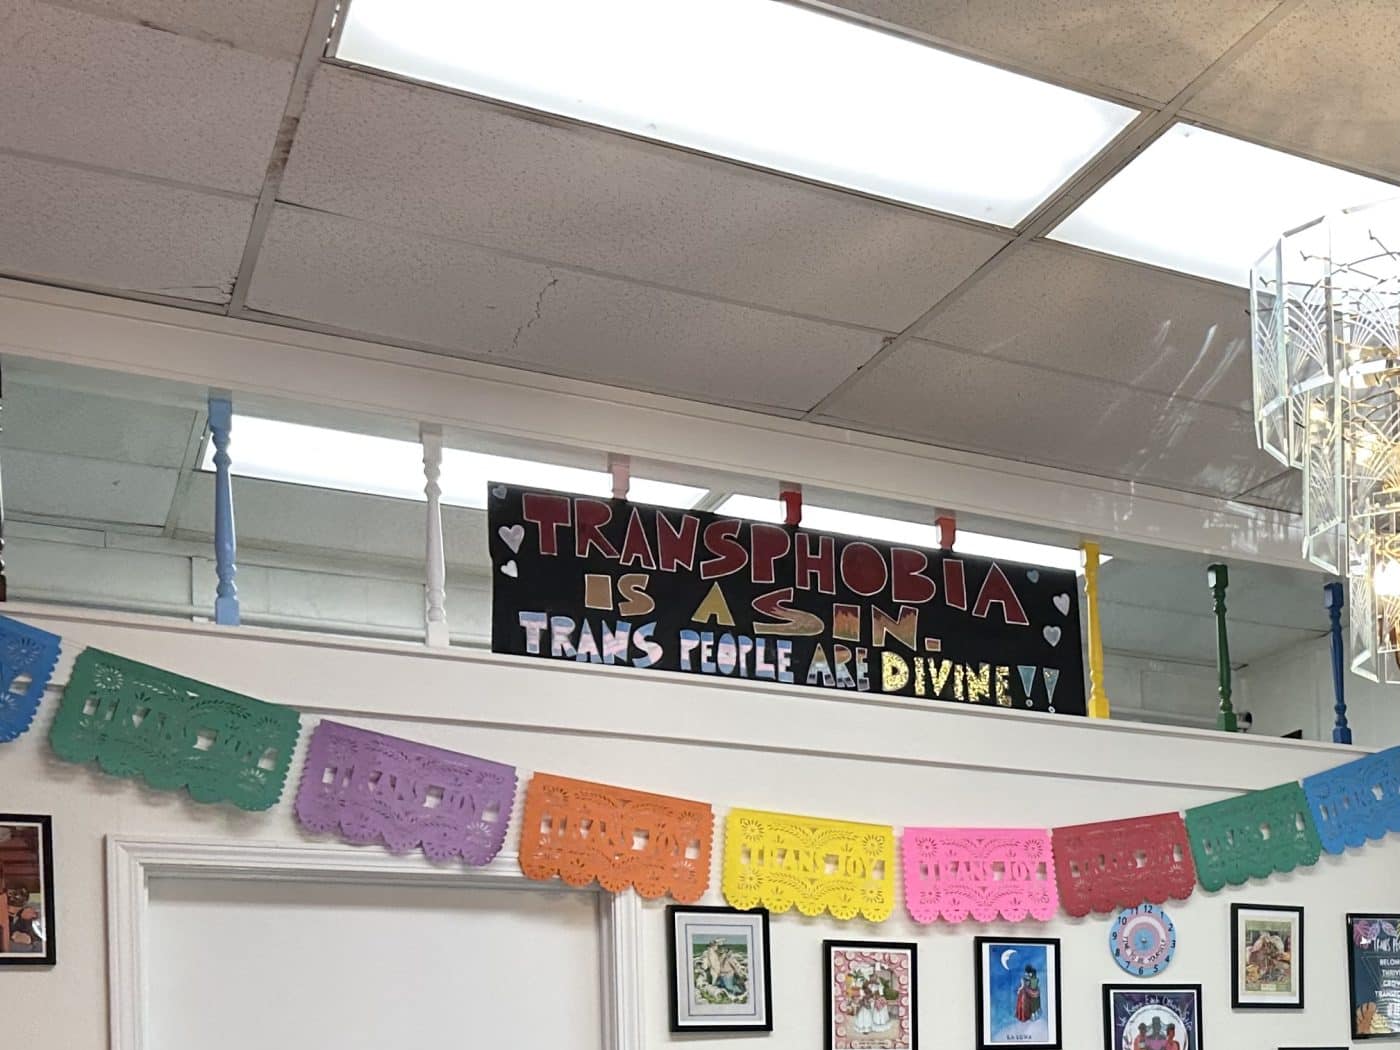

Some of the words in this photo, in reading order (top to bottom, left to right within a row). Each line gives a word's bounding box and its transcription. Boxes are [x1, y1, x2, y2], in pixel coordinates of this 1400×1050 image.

[522, 493, 1030, 625] TRANSPHOBIA
[584, 573, 655, 616] IS
[692, 581, 736, 626] A
[751, 587, 941, 652] SIN.
[519, 611, 664, 669] TRANS
[679, 629, 794, 683] PEOPLE
[807, 642, 870, 690] ARE
[1144, 904, 1153, 914] 12
[1118, 916, 1127, 926] 10
[1168, 922, 1174, 932] 2
[1112, 931, 1118, 941] 9
[1123, 960, 1131, 969] 7
[1153, 963, 1159, 973] 5
[1138, 966, 1144, 976] 6
